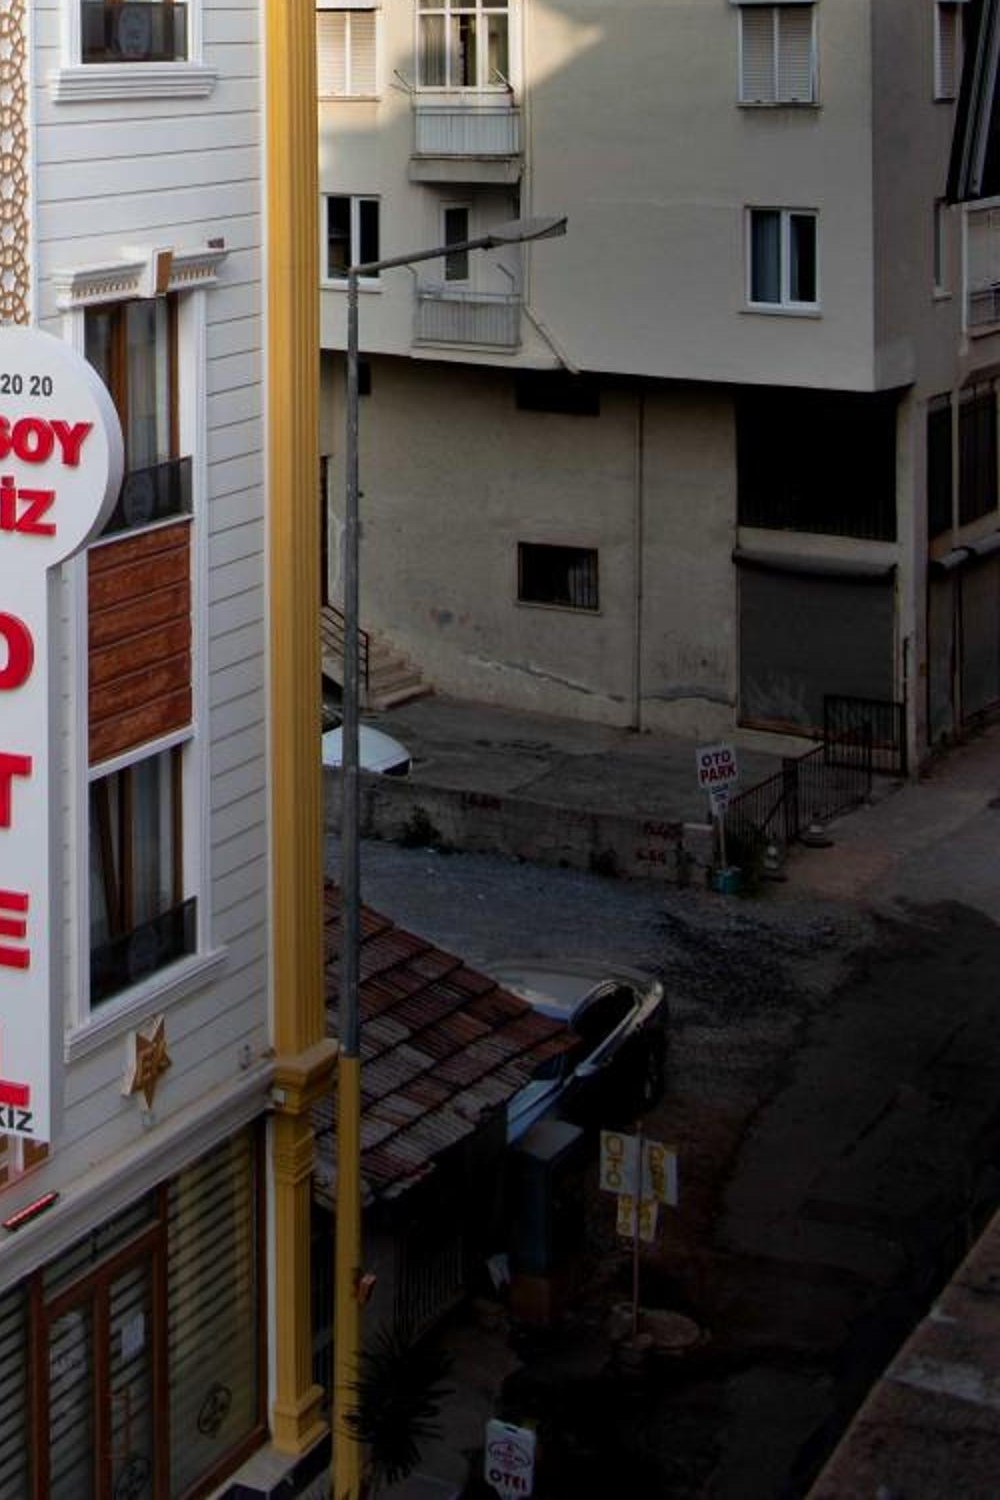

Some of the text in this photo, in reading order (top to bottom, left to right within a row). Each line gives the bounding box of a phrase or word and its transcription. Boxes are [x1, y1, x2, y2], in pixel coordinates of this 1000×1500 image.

[0, 373, 23, 395] 20
[29, 375, 53, 397] 20
[701, 750, 731, 767] OTO
[700, 762, 736, 783] PARK
